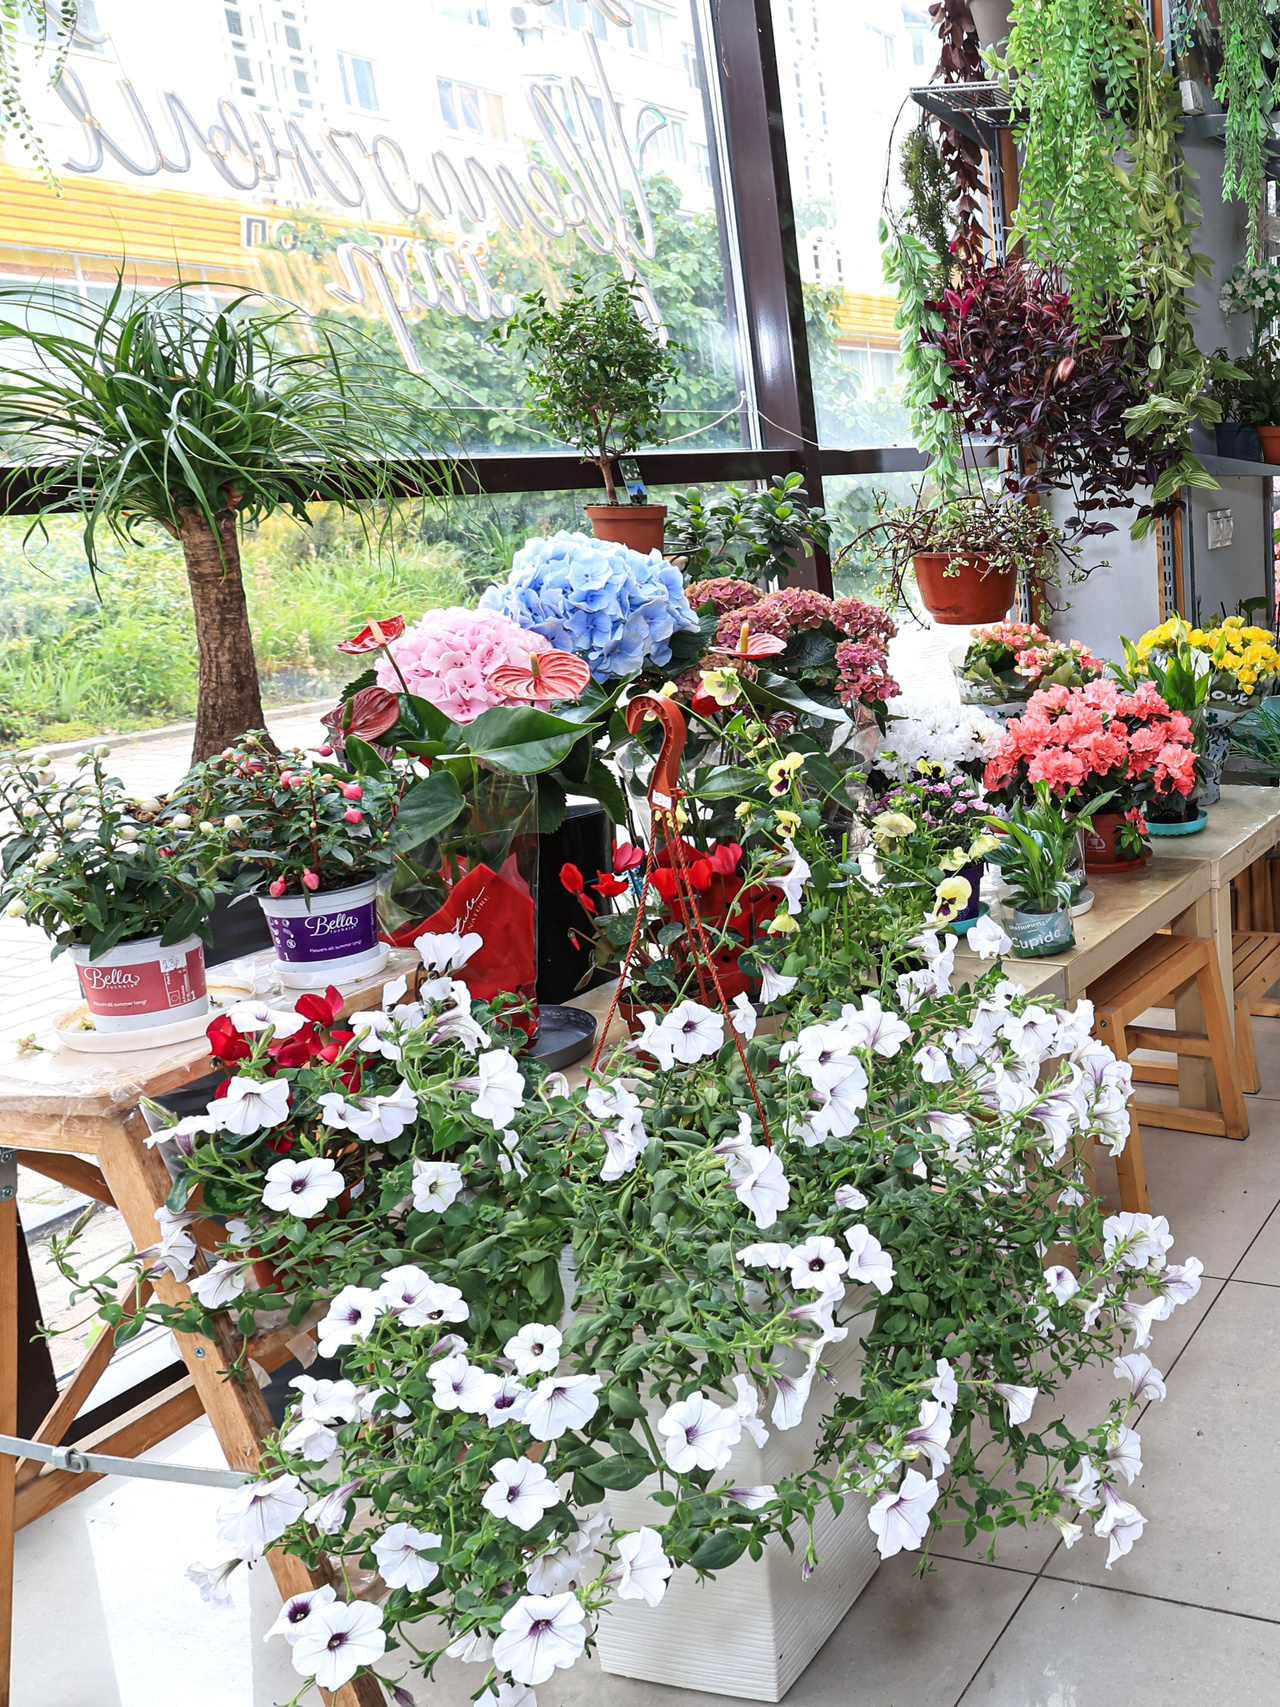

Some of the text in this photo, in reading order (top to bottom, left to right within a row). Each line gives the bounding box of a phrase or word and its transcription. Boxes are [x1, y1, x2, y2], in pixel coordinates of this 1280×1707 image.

[1211, 690, 1249, 706] OVE
[304, 913, 358, 937] Bella
[1011, 929, 1061, 950] Cupido
[83, 967, 140, 990] Bella
